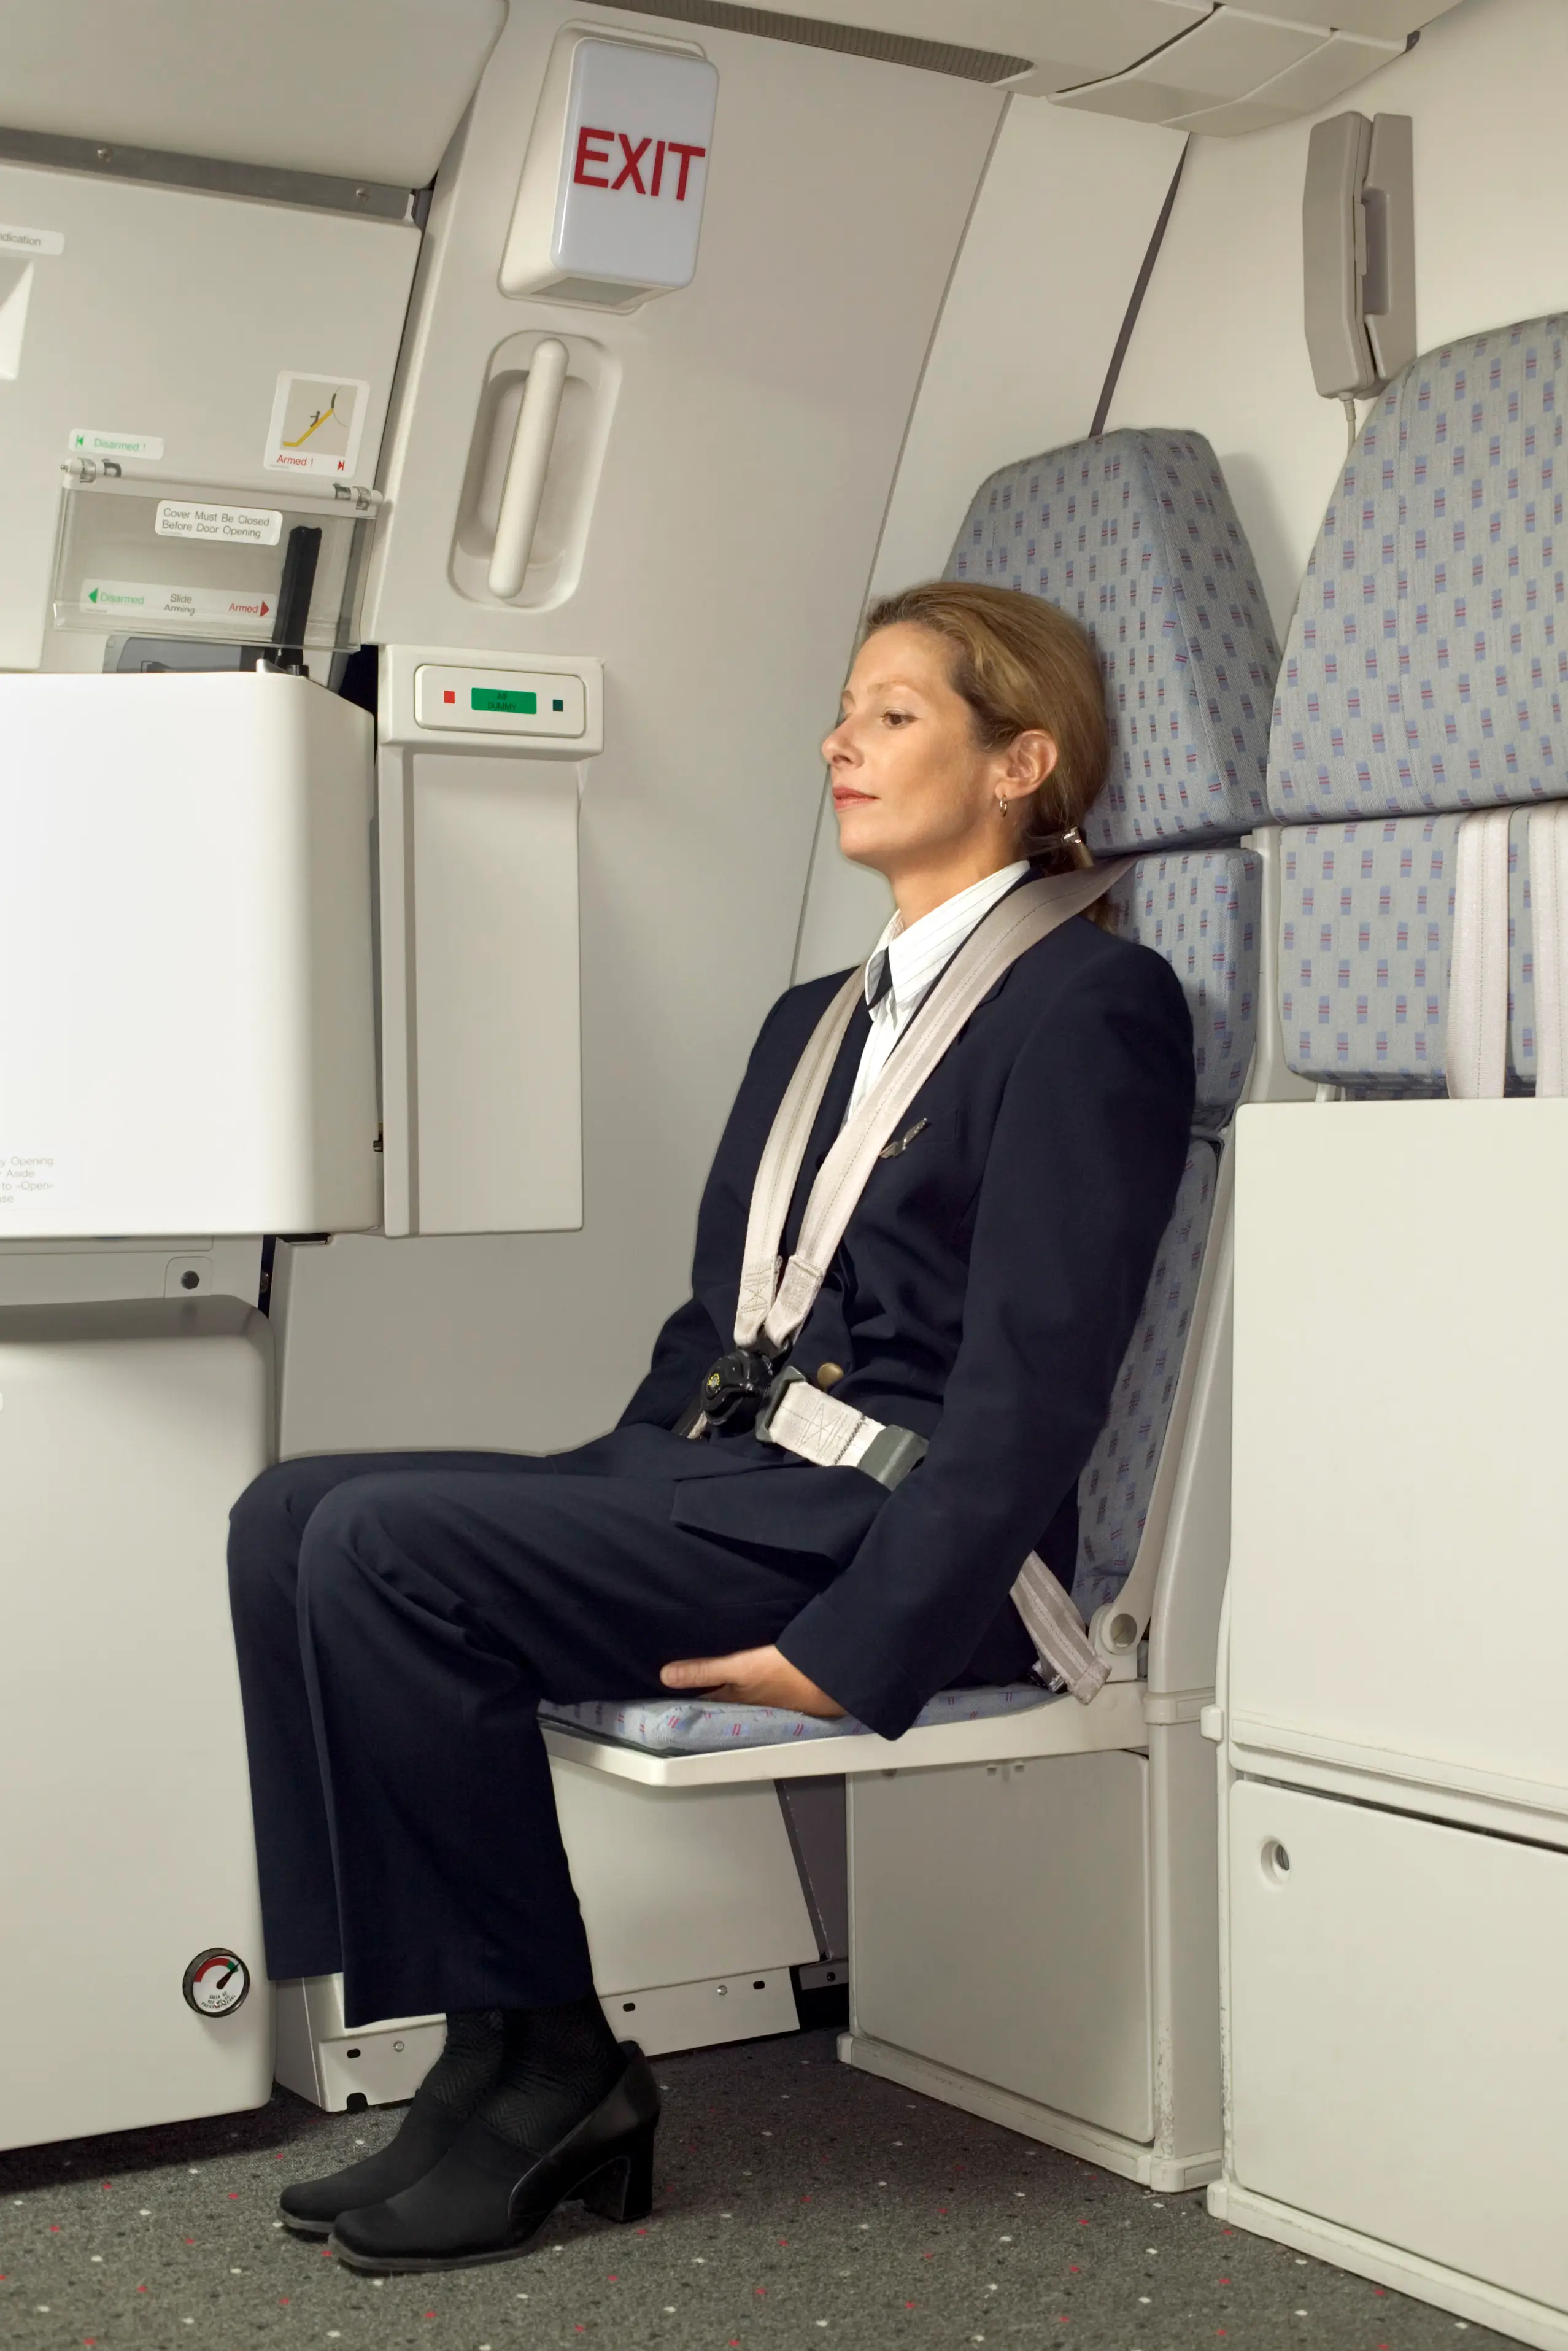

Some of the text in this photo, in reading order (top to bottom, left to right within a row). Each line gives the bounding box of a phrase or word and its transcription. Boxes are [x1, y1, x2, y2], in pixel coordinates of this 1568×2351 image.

[573, 126, 706, 201] EXIT
[95, 438, 140, 451] Disarmed
[277, 454, 307, 467] Armed
[163, 508, 271, 527] Cover Must Be Closed
[161, 519, 261, 540] Before Door Opening
[100, 592, 145, 605] Disarmed
[170, 593, 193, 604] Slide
[164, 604, 196, 616] Arming
[228, 603, 258, 614] Armed
[11, 1156, 54, 1168] Opening
[6, 1169, 35, 1178] Aside
